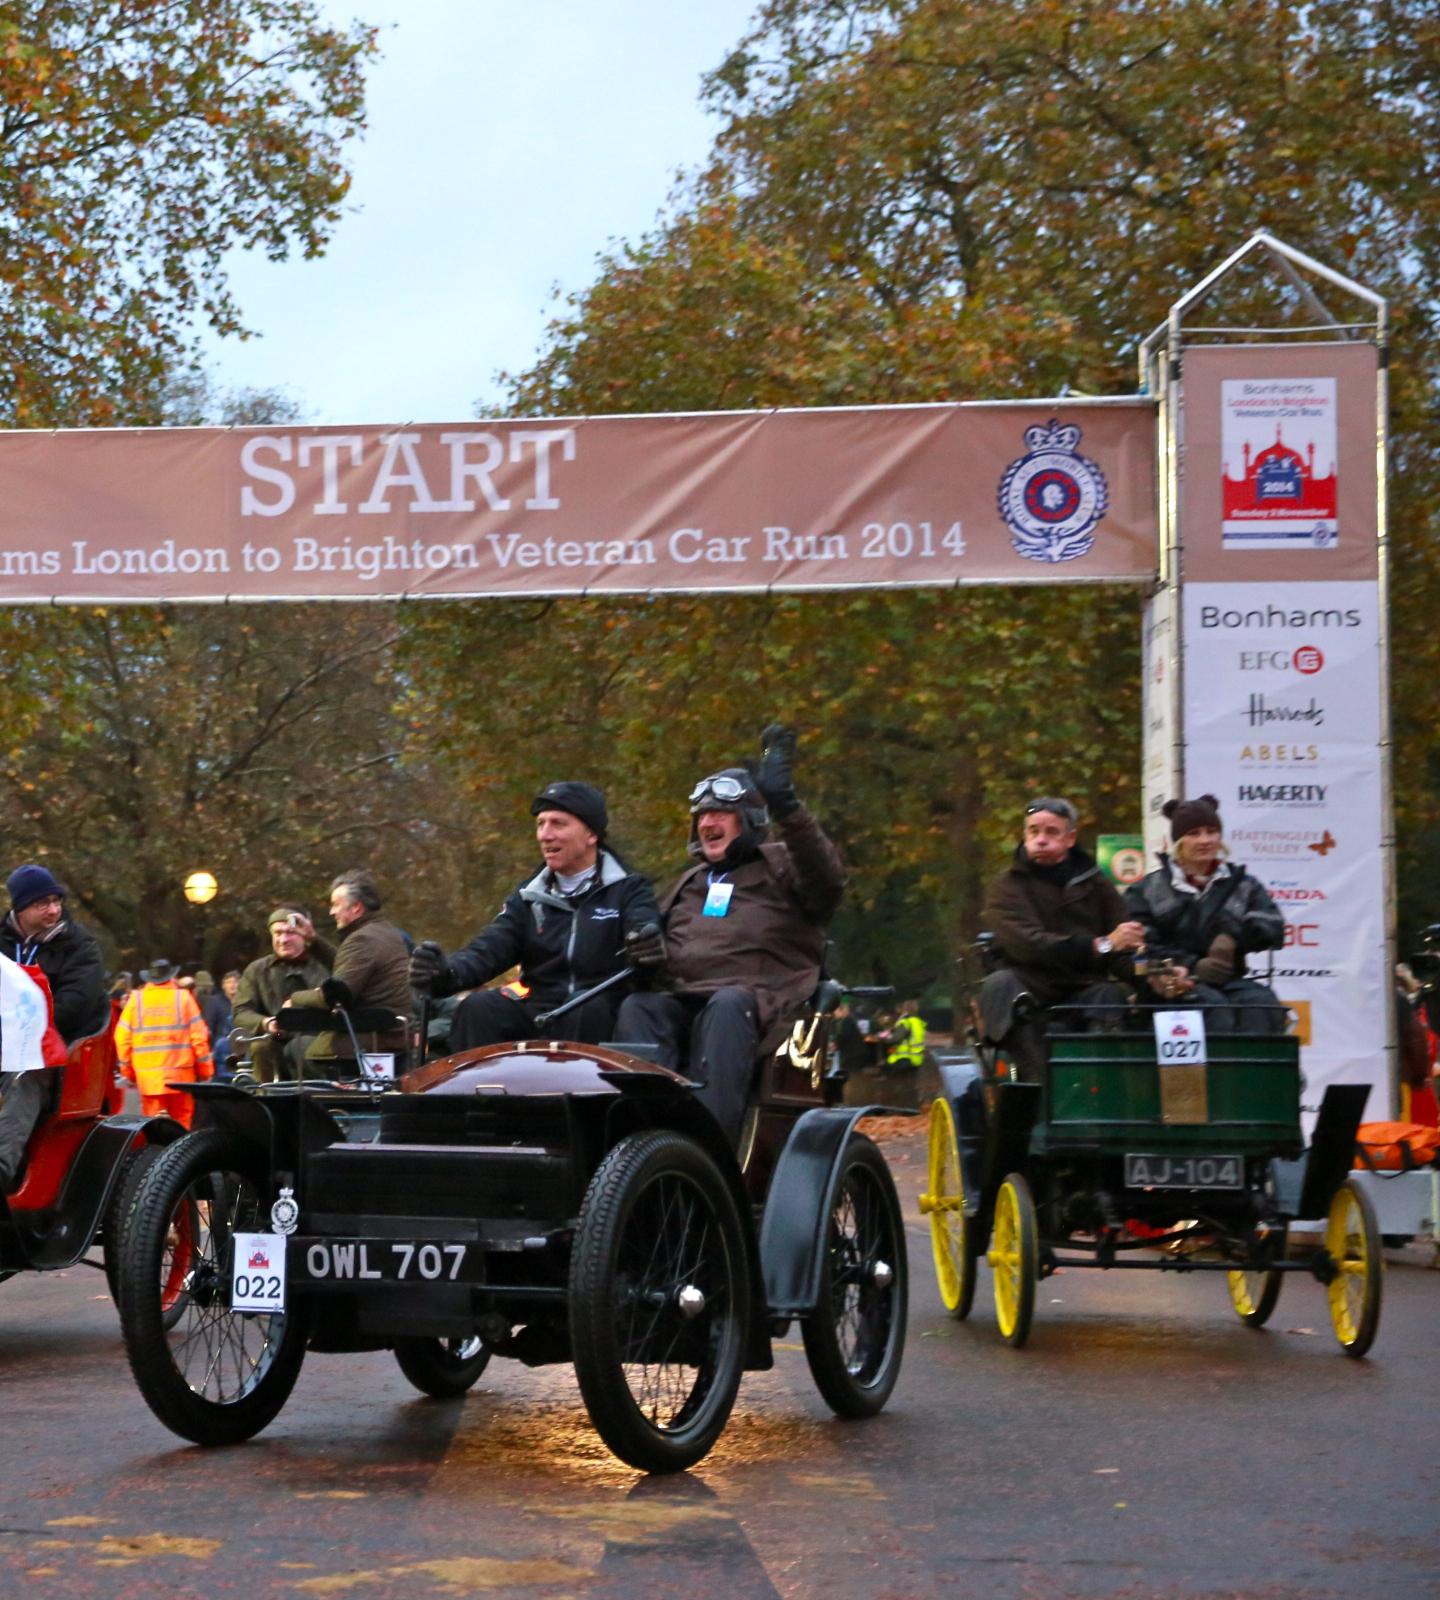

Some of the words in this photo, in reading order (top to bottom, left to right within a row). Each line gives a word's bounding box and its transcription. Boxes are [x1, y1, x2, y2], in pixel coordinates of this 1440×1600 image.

[240, 429, 576, 517] START
[1263, 481, 1295, 493] 2014
[71, 537, 230, 574] London
[242, 541, 282, 573] to
[293, 536, 480, 581] Brighton
[485, 533, 657, 569] Veteran
[668, 527, 752, 564] Car
[762, 525, 849, 562] Run
[861, 522, 967, 559] 2014
[1200, 604, 1361, 628] Bonhams
[1239, 651, 1290, 670] EFG
[1241, 693, 1324, 726] Harrods
[1239, 745, 1318, 761] ABELS
[1238, 785, 1327, 801] HAGERTY
[1250, 967, 1334, 977] ctane
[1161, 1040, 1201, 1058] 027
[1131, 1158, 1237, 1185] AJ-104
[307, 1244, 382, 1279] OWL
[391, 1244, 466, 1280] 707
[235, 1275, 281, 1299] 022
